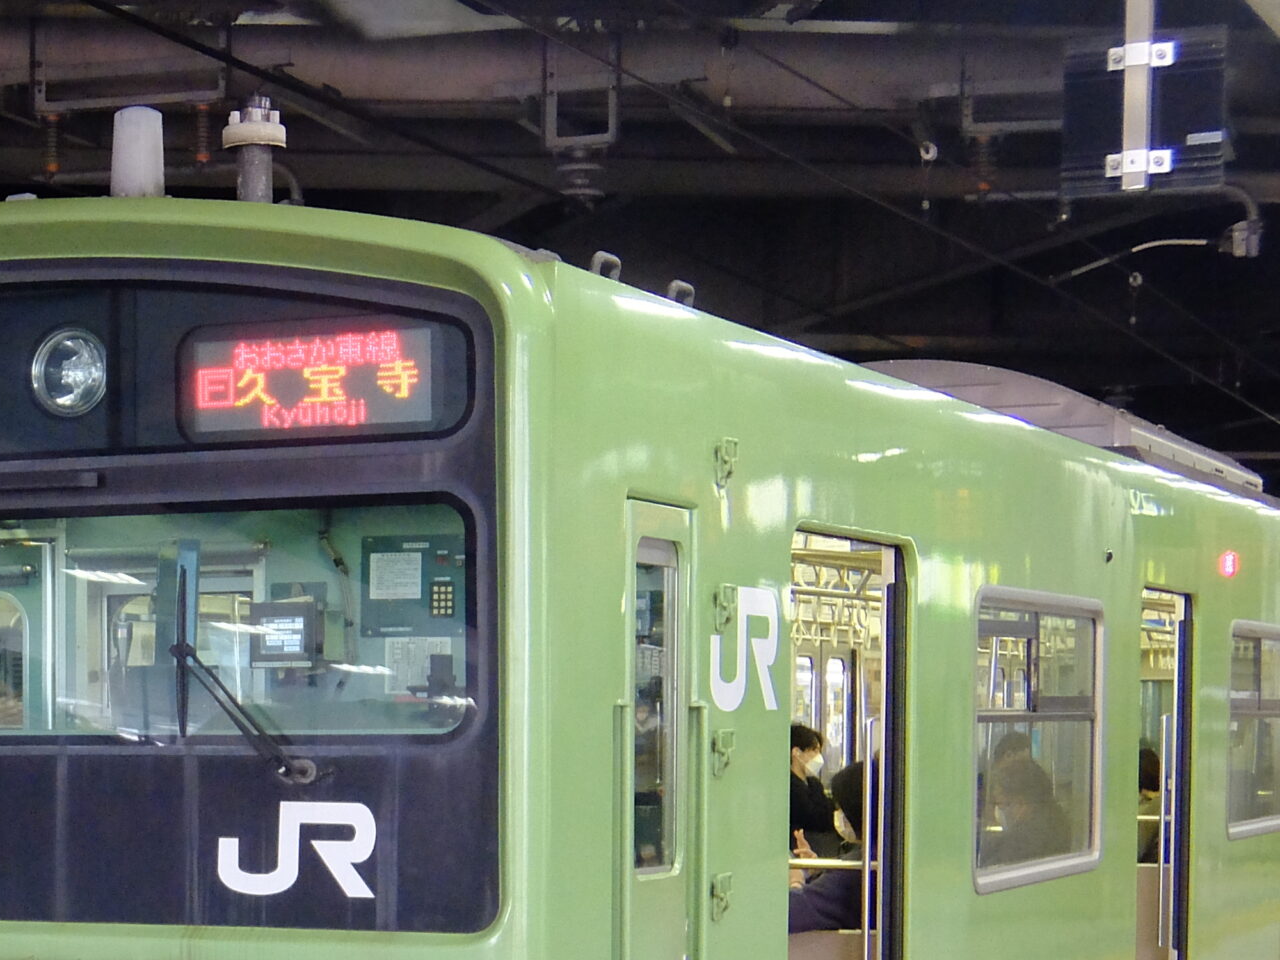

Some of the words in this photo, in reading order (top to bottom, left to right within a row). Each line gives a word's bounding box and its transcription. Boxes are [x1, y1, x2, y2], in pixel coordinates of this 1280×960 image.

[234, 360, 419, 407] 久宝寺
[235, 330, 400, 369] おおさか東線
[710, 586, 779, 712] JR
[217, 801, 377, 898] JR
